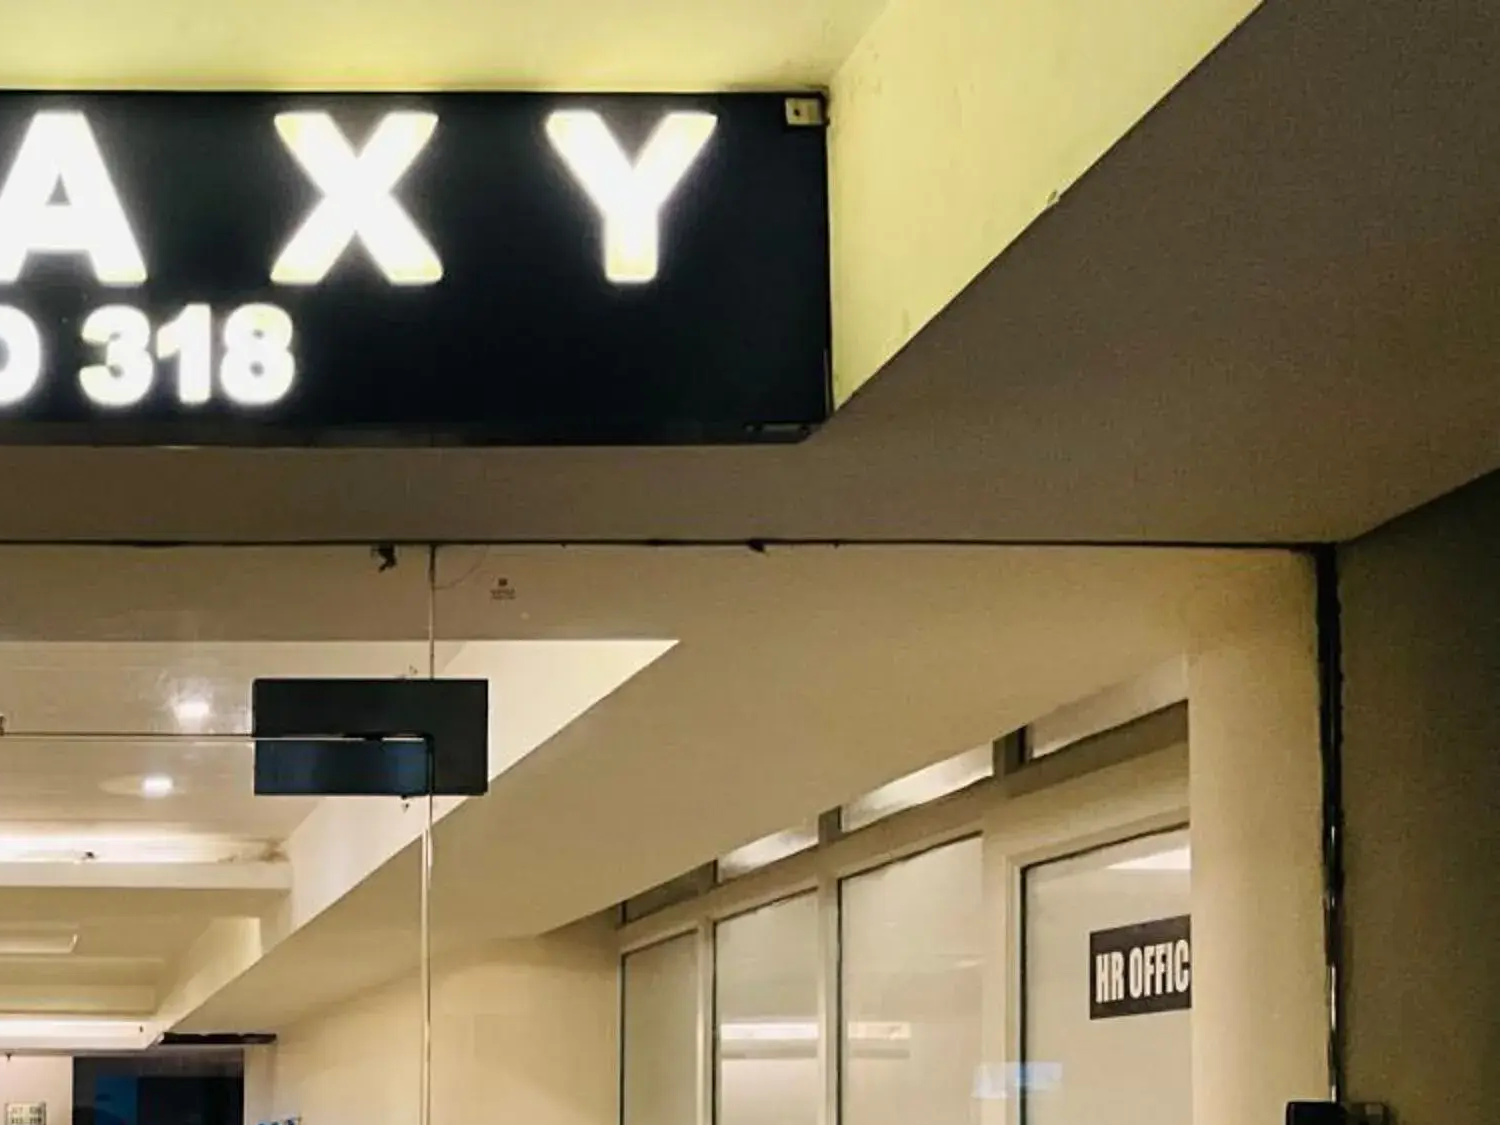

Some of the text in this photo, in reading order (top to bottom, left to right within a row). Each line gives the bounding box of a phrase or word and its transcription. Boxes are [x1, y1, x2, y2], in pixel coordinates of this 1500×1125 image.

[78, 304, 296, 406] 318
[1096, 939, 1190, 1003] HR OFFIC
